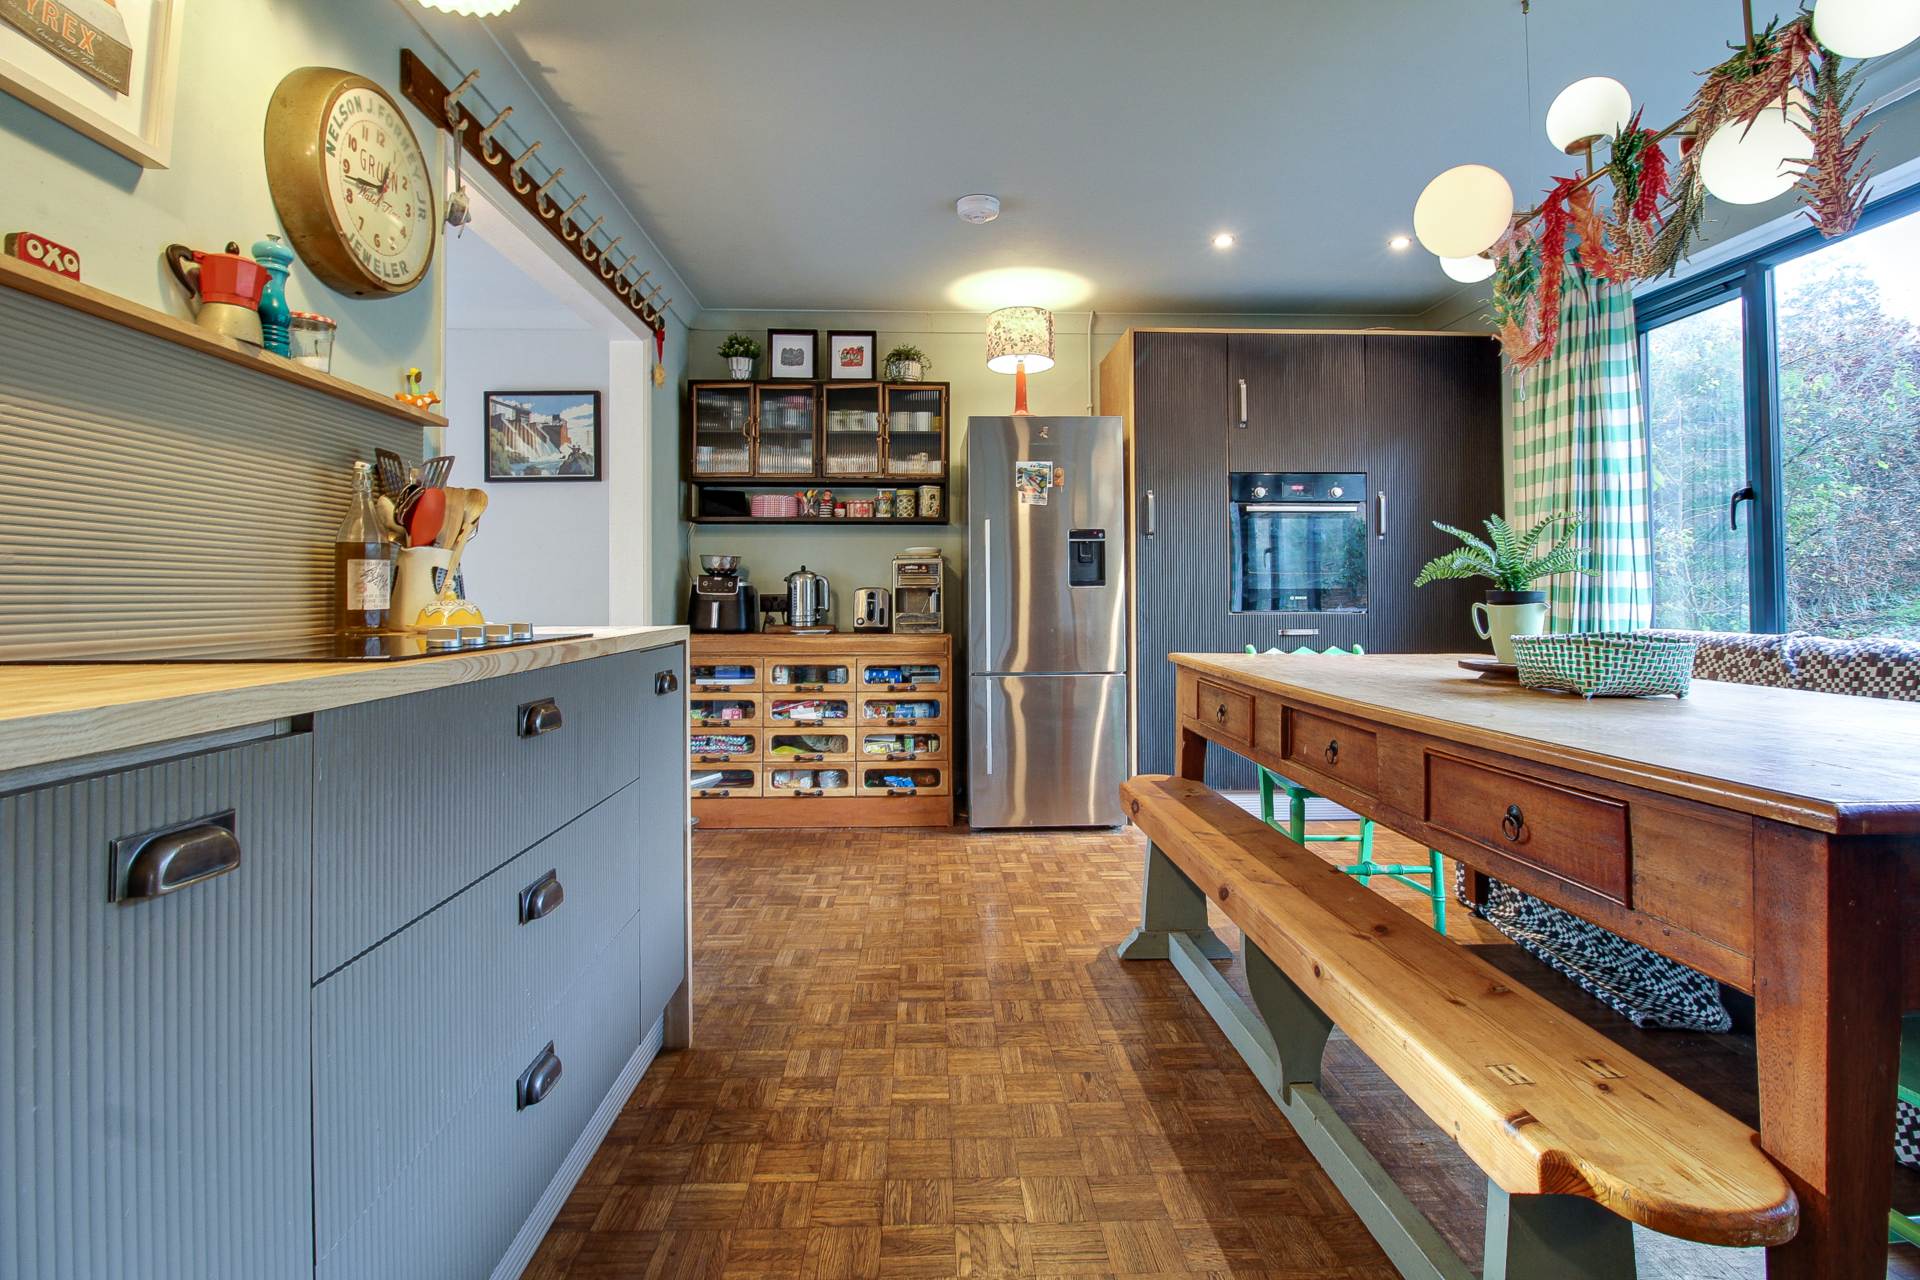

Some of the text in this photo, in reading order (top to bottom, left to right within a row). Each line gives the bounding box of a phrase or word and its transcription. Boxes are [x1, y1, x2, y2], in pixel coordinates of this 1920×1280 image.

[326, 96, 363, 158] NELSON
[362, 126, 369, 142] 11
[348, 134, 357, 152] 10
[376, 129, 386, 148] 12
[342, 158, 350, 174] 9
[360, 148, 398, 195] GRUN
[402, 175, 408, 192] 2
[346, 188, 353, 205] 8
[405, 203, 412, 218] 3
[358, 216, 364, 231] 7
[373, 233, 381, 248] 6
[26, 239, 79, 273] OXO
[347, 233, 409, 278] JEWELER
